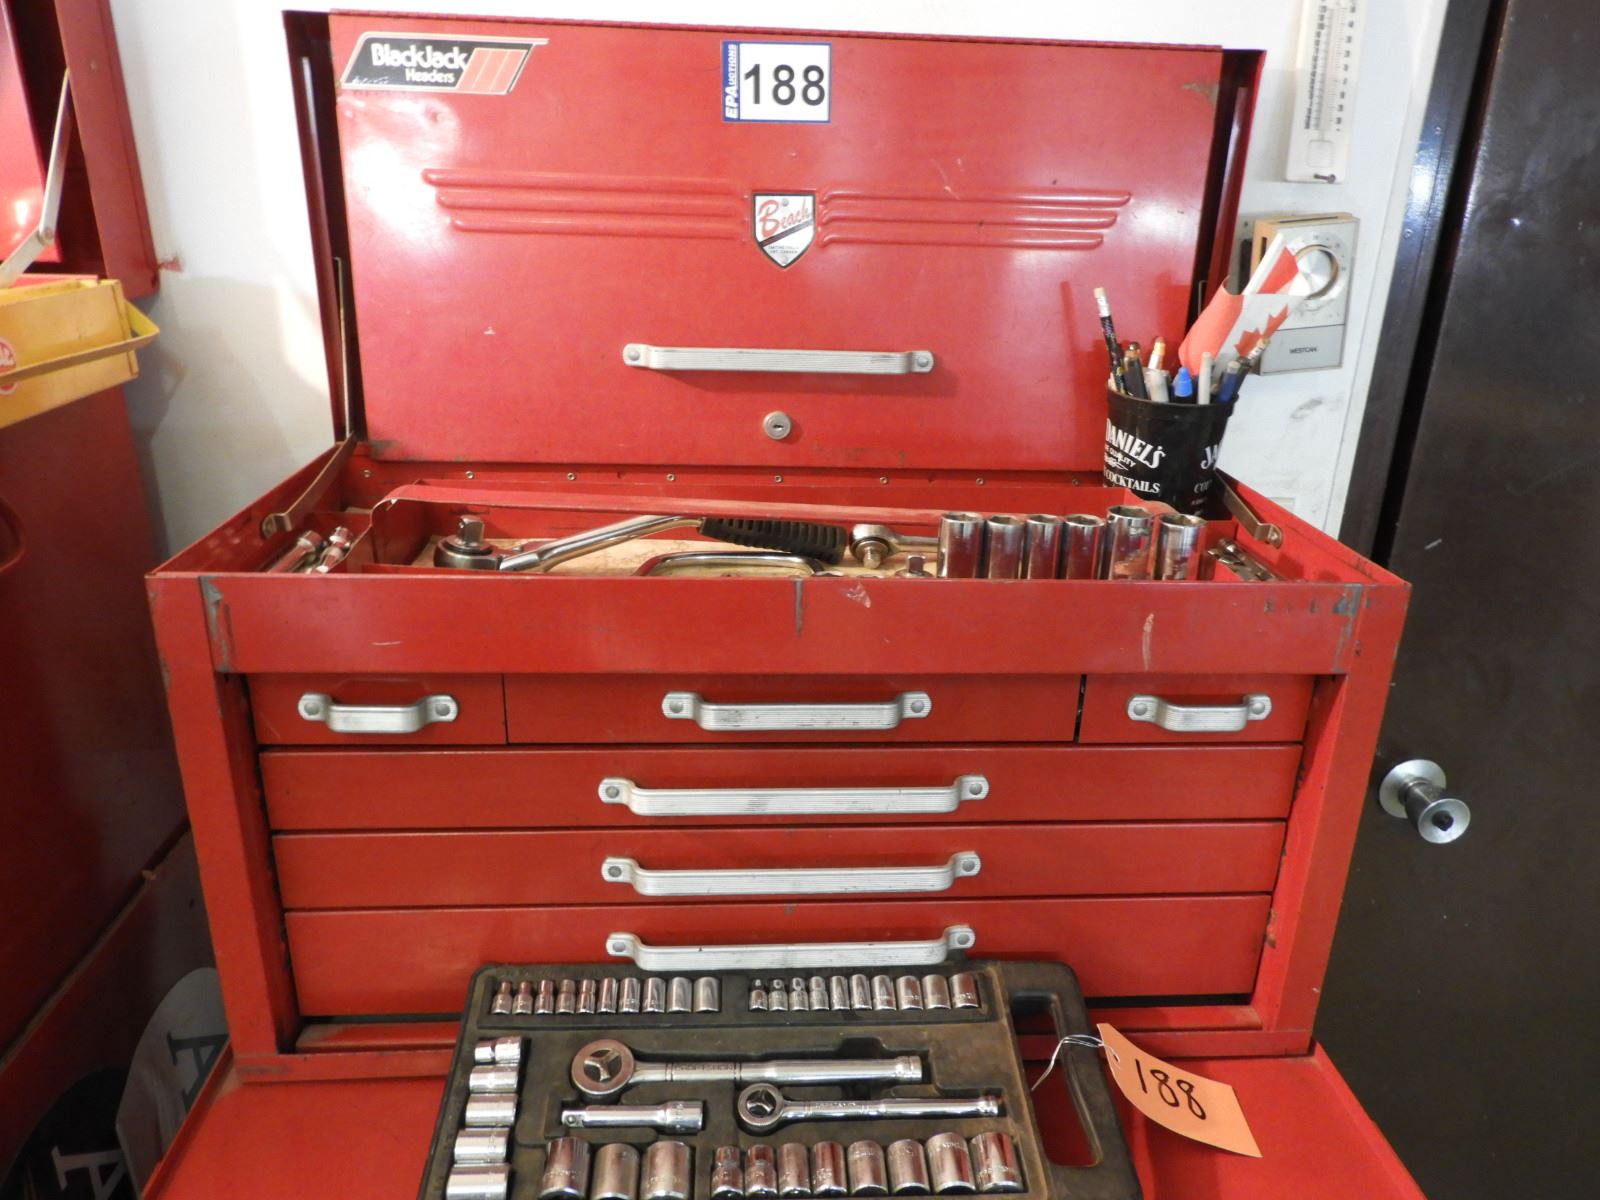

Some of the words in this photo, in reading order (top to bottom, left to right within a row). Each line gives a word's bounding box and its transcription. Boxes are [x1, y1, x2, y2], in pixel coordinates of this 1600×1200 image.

[371, 43, 468, 70] BlackJack
[405, 68, 456, 83] Headers
[744, 64, 826, 106] 188
[758, 199, 811, 238] Beach
[1135, 1058, 1207, 1121] 188
